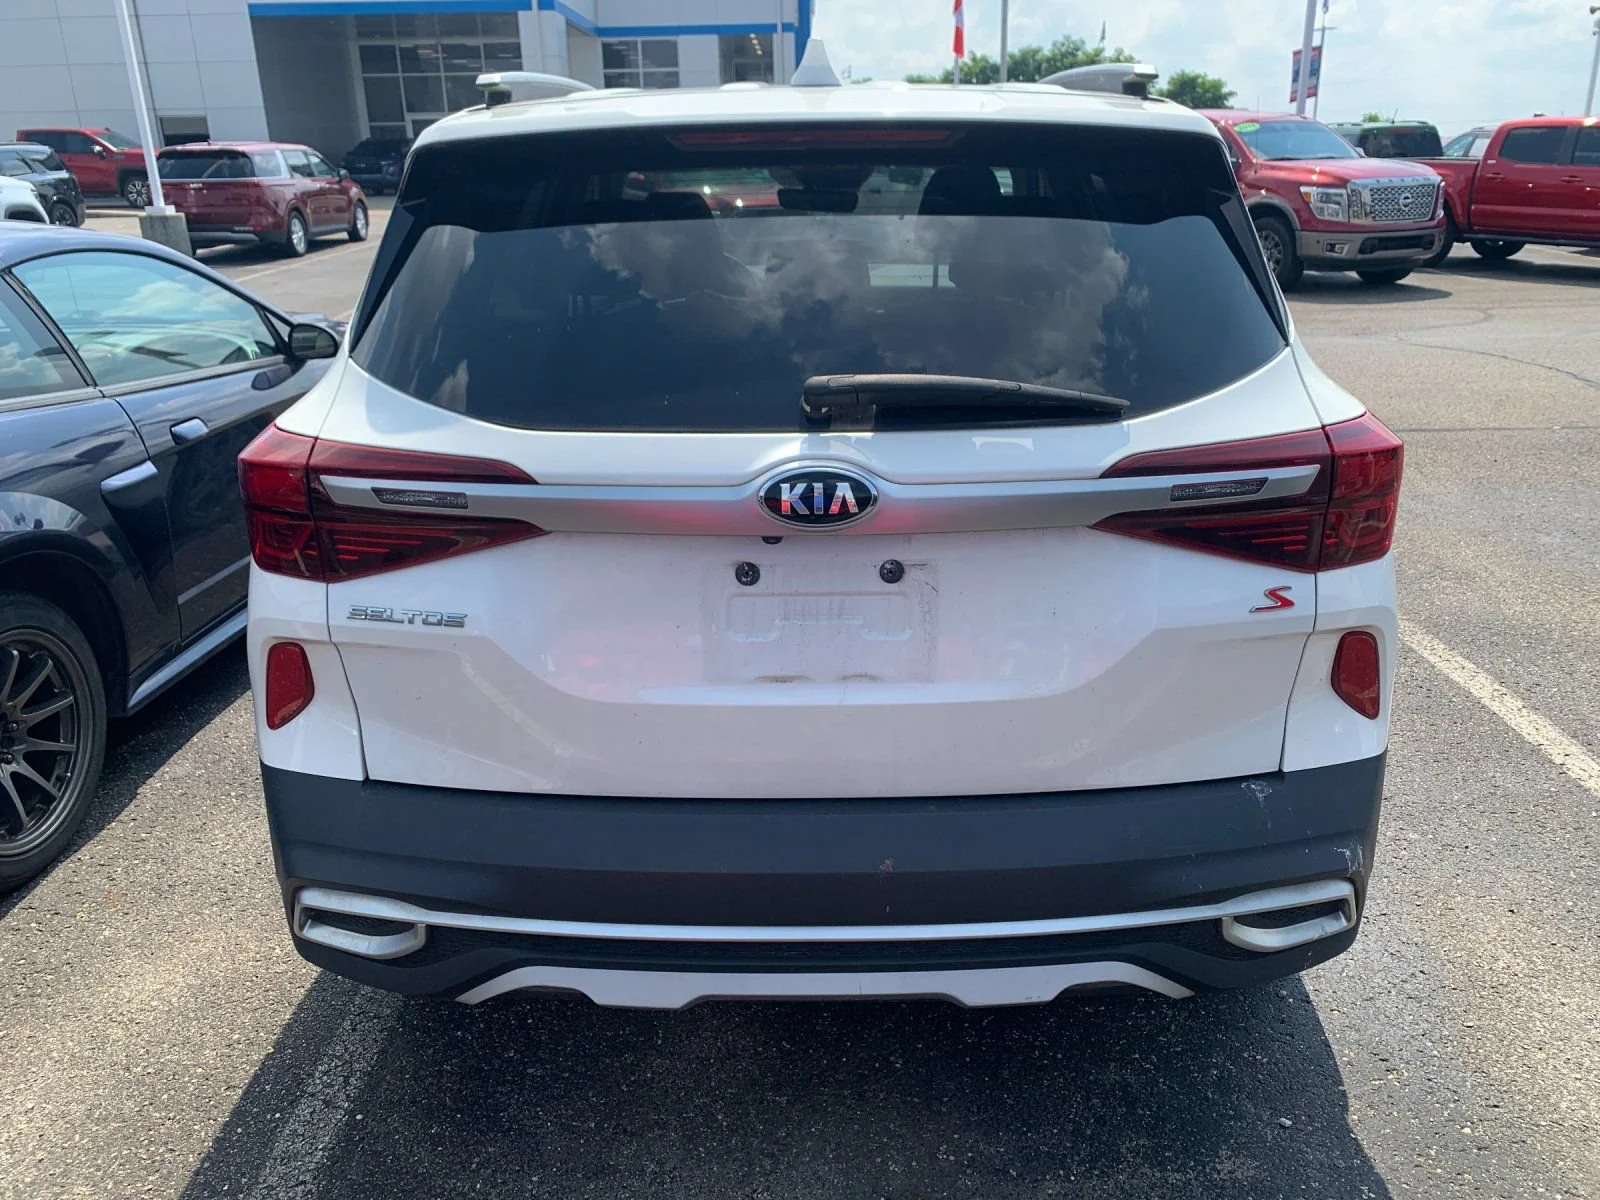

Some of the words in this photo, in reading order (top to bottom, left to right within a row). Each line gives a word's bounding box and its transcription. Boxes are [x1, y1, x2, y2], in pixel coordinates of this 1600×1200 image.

[779, 482, 859, 515] KIA
[1249, 585, 1295, 613] S
[346, 604, 468, 629] SELTOS
